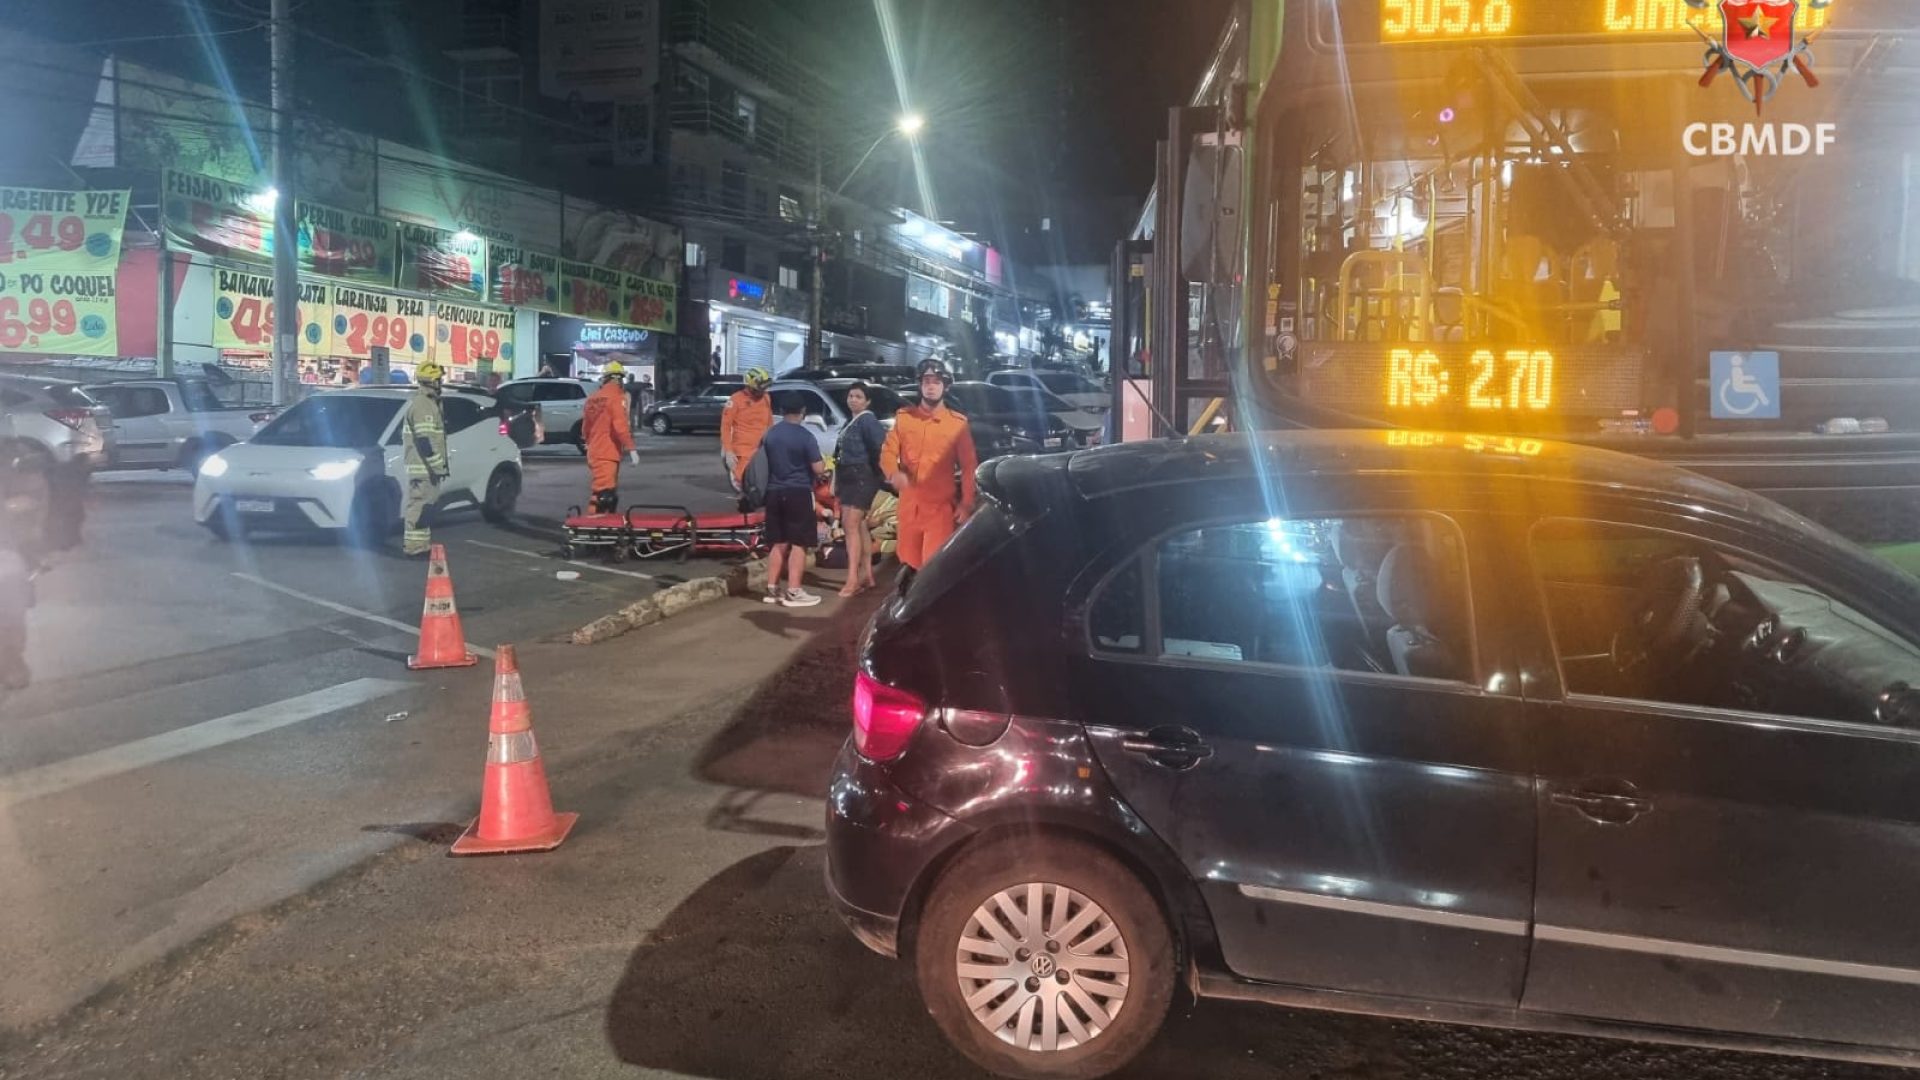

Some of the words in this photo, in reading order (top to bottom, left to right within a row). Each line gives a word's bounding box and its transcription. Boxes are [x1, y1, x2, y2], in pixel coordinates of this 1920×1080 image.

[85, 192, 120, 214] YPE
[298, 282, 326, 305] RATA
[397, 298, 424, 317] PERA
[438, 303, 485, 327] CENOURA
[489, 312, 515, 330] EXTRA
[1388, 349, 1448, 406] R$:
[1469, 350, 1553, 409] 2.70
